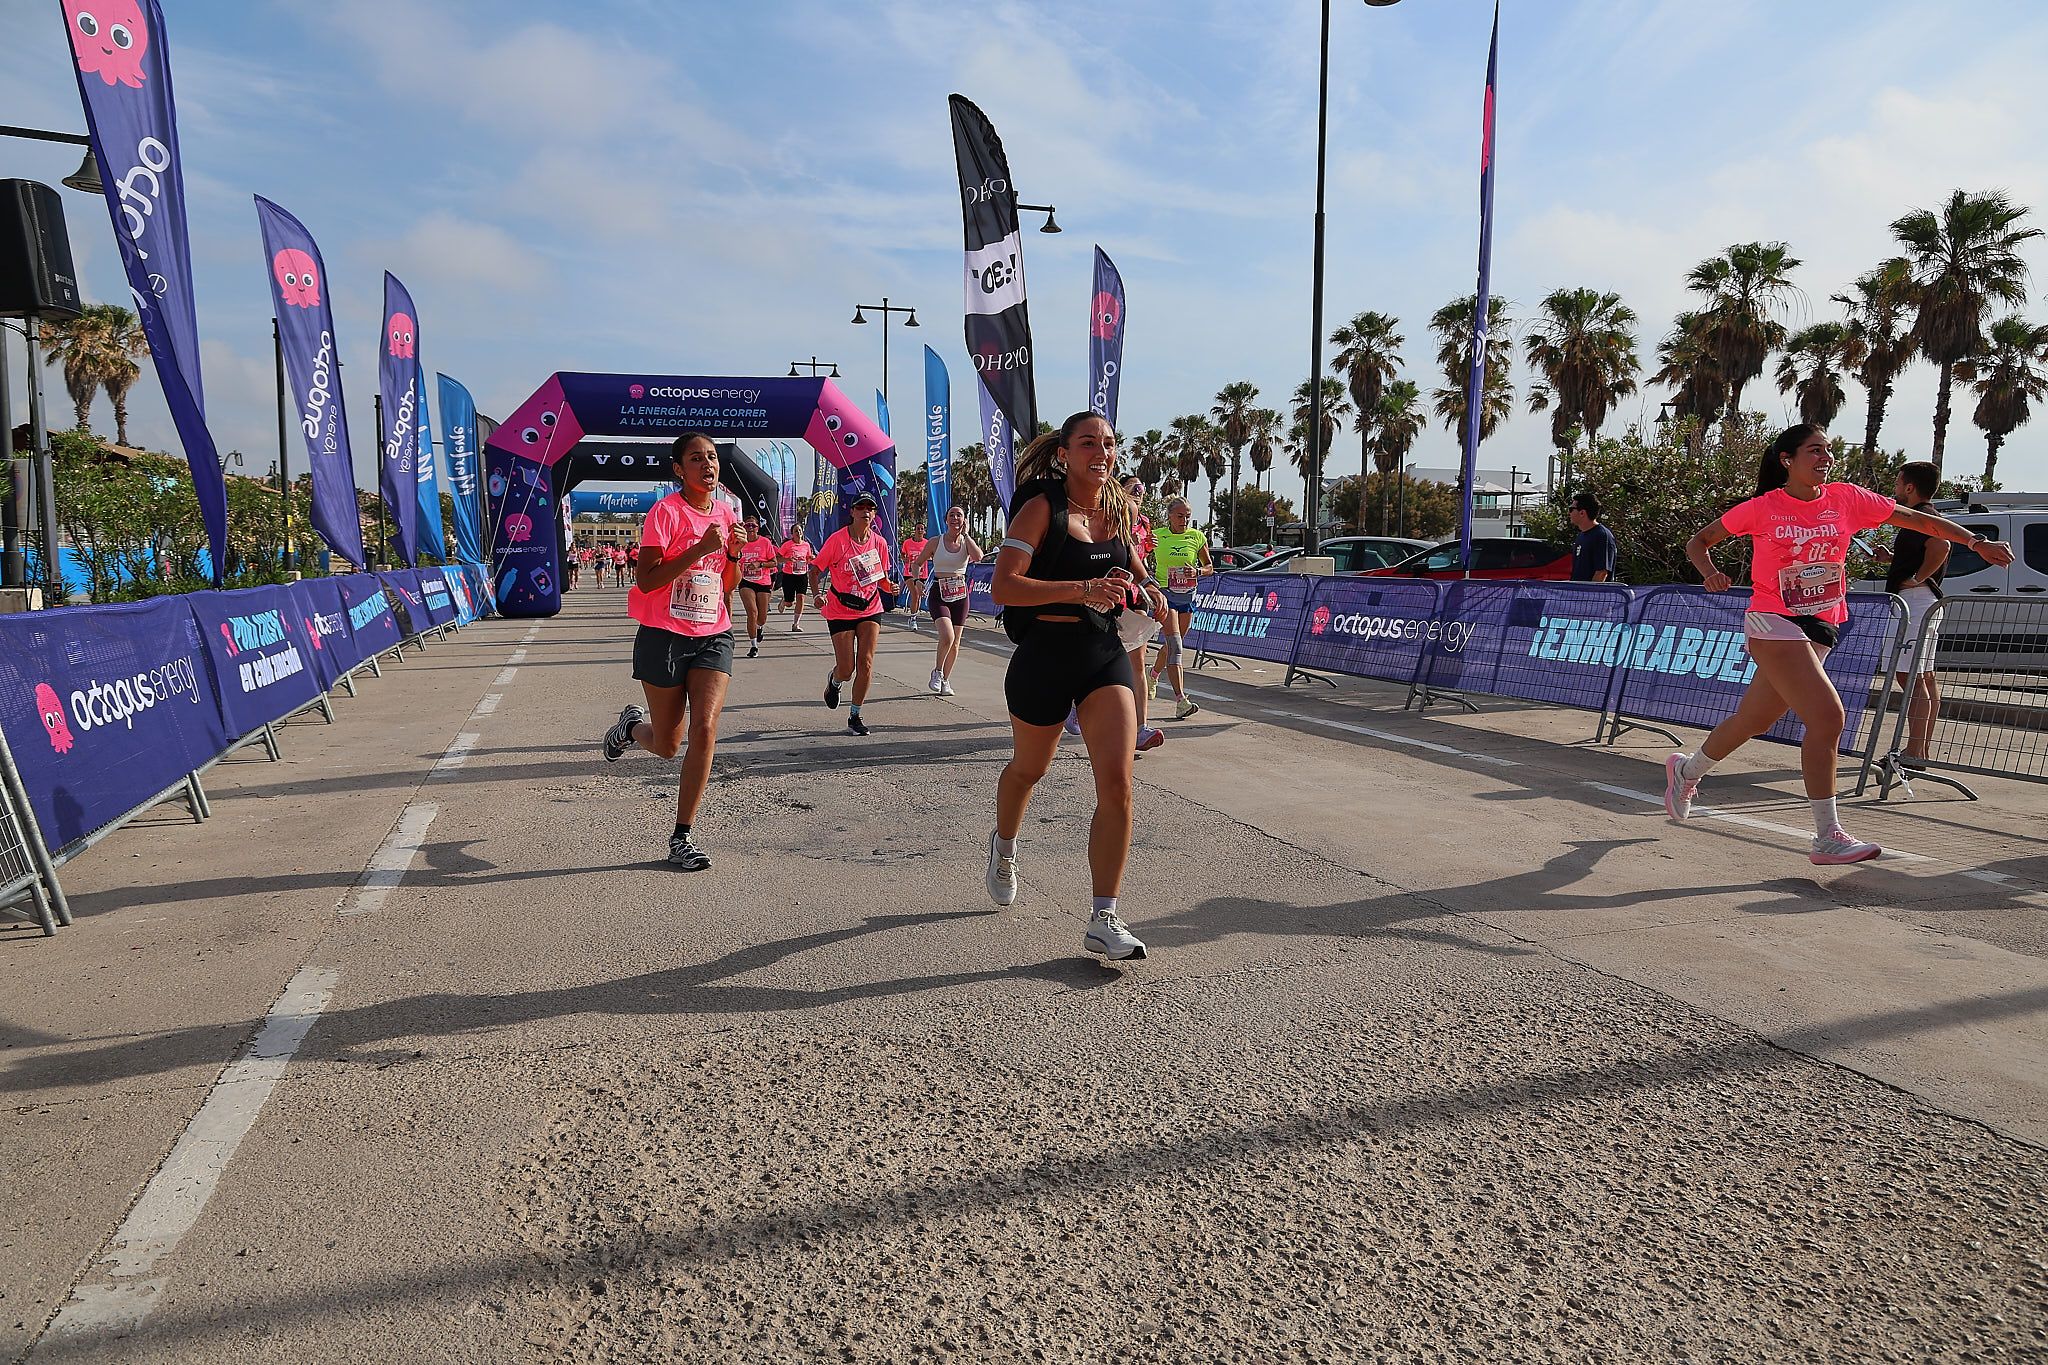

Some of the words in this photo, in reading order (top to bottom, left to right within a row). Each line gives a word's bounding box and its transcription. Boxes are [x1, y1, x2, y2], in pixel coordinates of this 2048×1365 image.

[649, 386, 710, 401] octopus
[711, 388, 761, 404] energy
[620, 405, 635, 415] LA
[638, 405, 687, 417] ENERGÍA
[689, 408, 720, 418] PARA
[722, 408, 767, 418] CORRER
[619, 417, 628, 426] A
[631, 417, 645, 427] LA
[648, 418, 712, 428] VELOCIDAD
[713, 419, 728, 428] DE
[730, 420, 745, 428] LA
[747, 420, 769, 428] LUZ
[592, 454, 674, 466] VOL
[690, 593, 709, 604] 016
[1802, 585, 1825, 597] 016
[1201, 590, 1252, 612] alcanzado
[1251, 592, 1264, 613] la
[1216, 613, 1234, 634] DE
[1231, 615, 1248, 637] LA
[1247, 616, 1271, 639] LUZ
[1333, 612, 1404, 642] octopus
[1403, 619, 1476, 653] energy
[70, 673, 155, 730] octopus
[149, 655, 201, 705] energy
